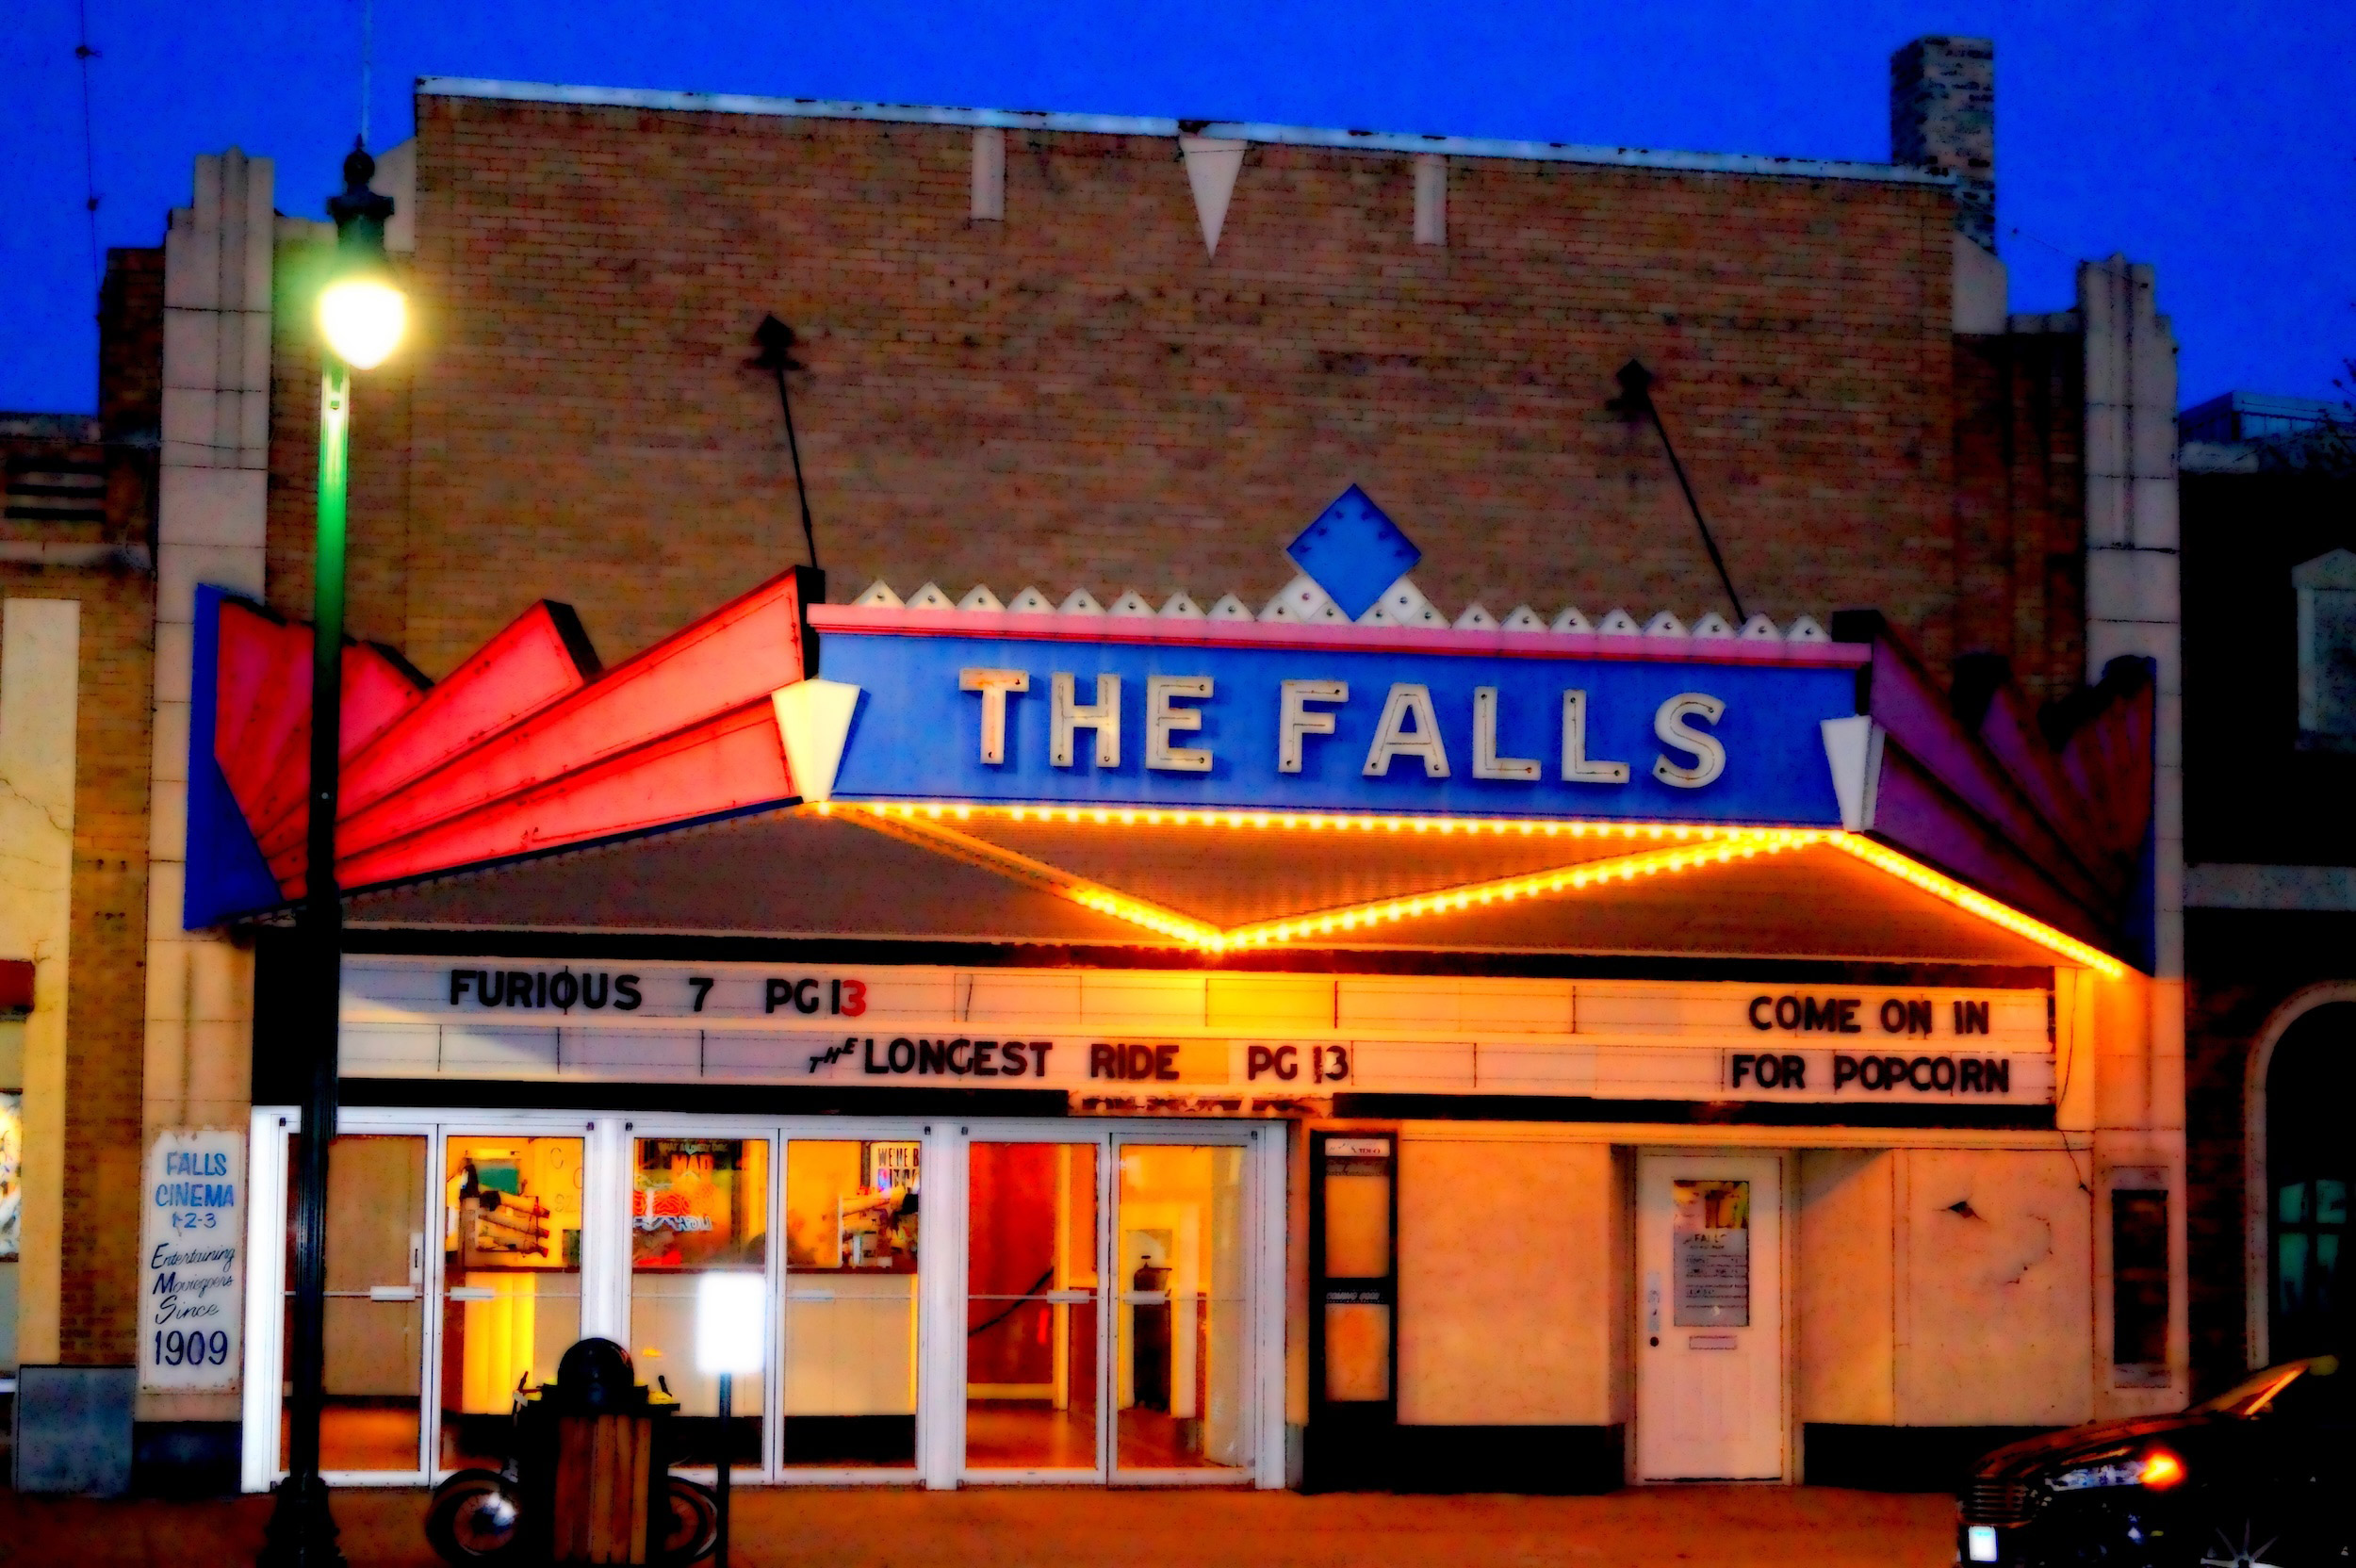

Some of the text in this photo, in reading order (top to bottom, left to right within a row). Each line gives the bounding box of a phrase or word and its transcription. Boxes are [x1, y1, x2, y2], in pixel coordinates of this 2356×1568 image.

[959, 668, 1726, 789] THE FALLS
[450, 970, 642, 1011] FURIOUS
[689, 977, 714, 1012] 7
[1748, 996, 1989, 1035] COME ON IN
[809, 1037, 859, 1073] THE
[865, 1038, 1053, 1076] LONGEST
[1090, 1043, 1180, 1080] RIDE
[1731, 1054, 2009, 1093] FOR POPCORN
[166, 1152, 227, 1176] FALLS
[155, 1182, 235, 1207] CINEMA
[172, 1212, 217, 1229] 1-2-3
[151, 1242, 236, 1273] Entertaining
[152, 1271, 235, 1298] Moviegoers
[155, 1295, 220, 1324] Since
[155, 1330, 228, 1365] 1909
